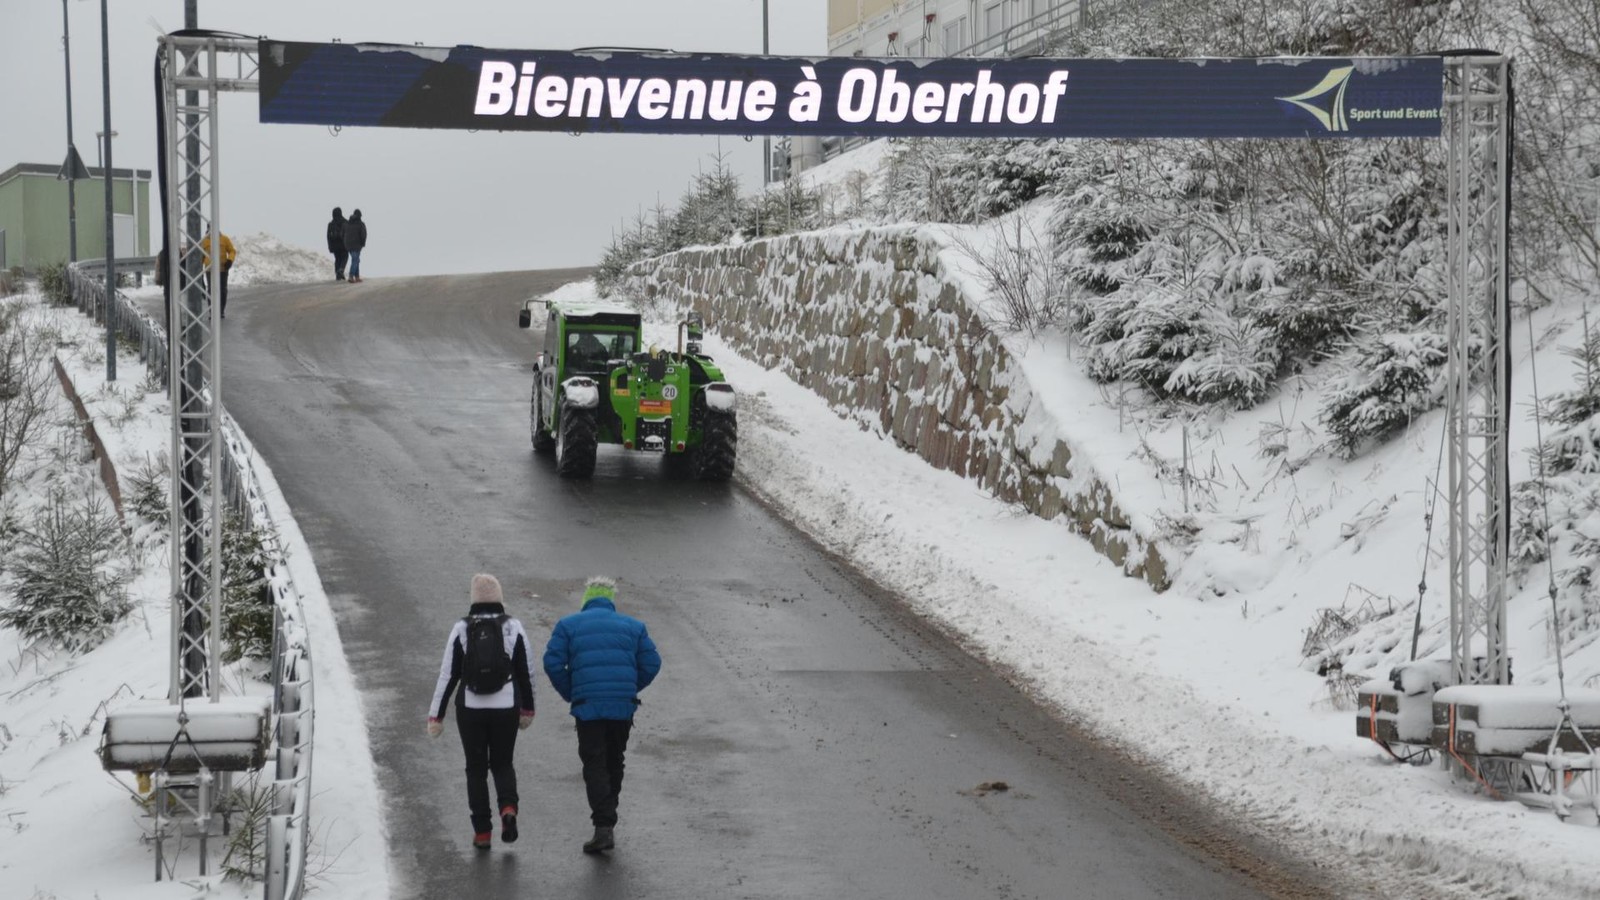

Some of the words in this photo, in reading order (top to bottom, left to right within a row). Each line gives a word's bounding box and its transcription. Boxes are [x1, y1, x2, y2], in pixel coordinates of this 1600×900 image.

[474, 60, 777, 122] Bienvenue
[788, 65, 823, 123] à
[837, 68, 1069, 124] Oberhof
[1350, 107, 1381, 121] Sport
[1382, 107, 1404, 119] und
[1405, 107, 1438, 119] Event
[664, 386, 676, 398] 20
